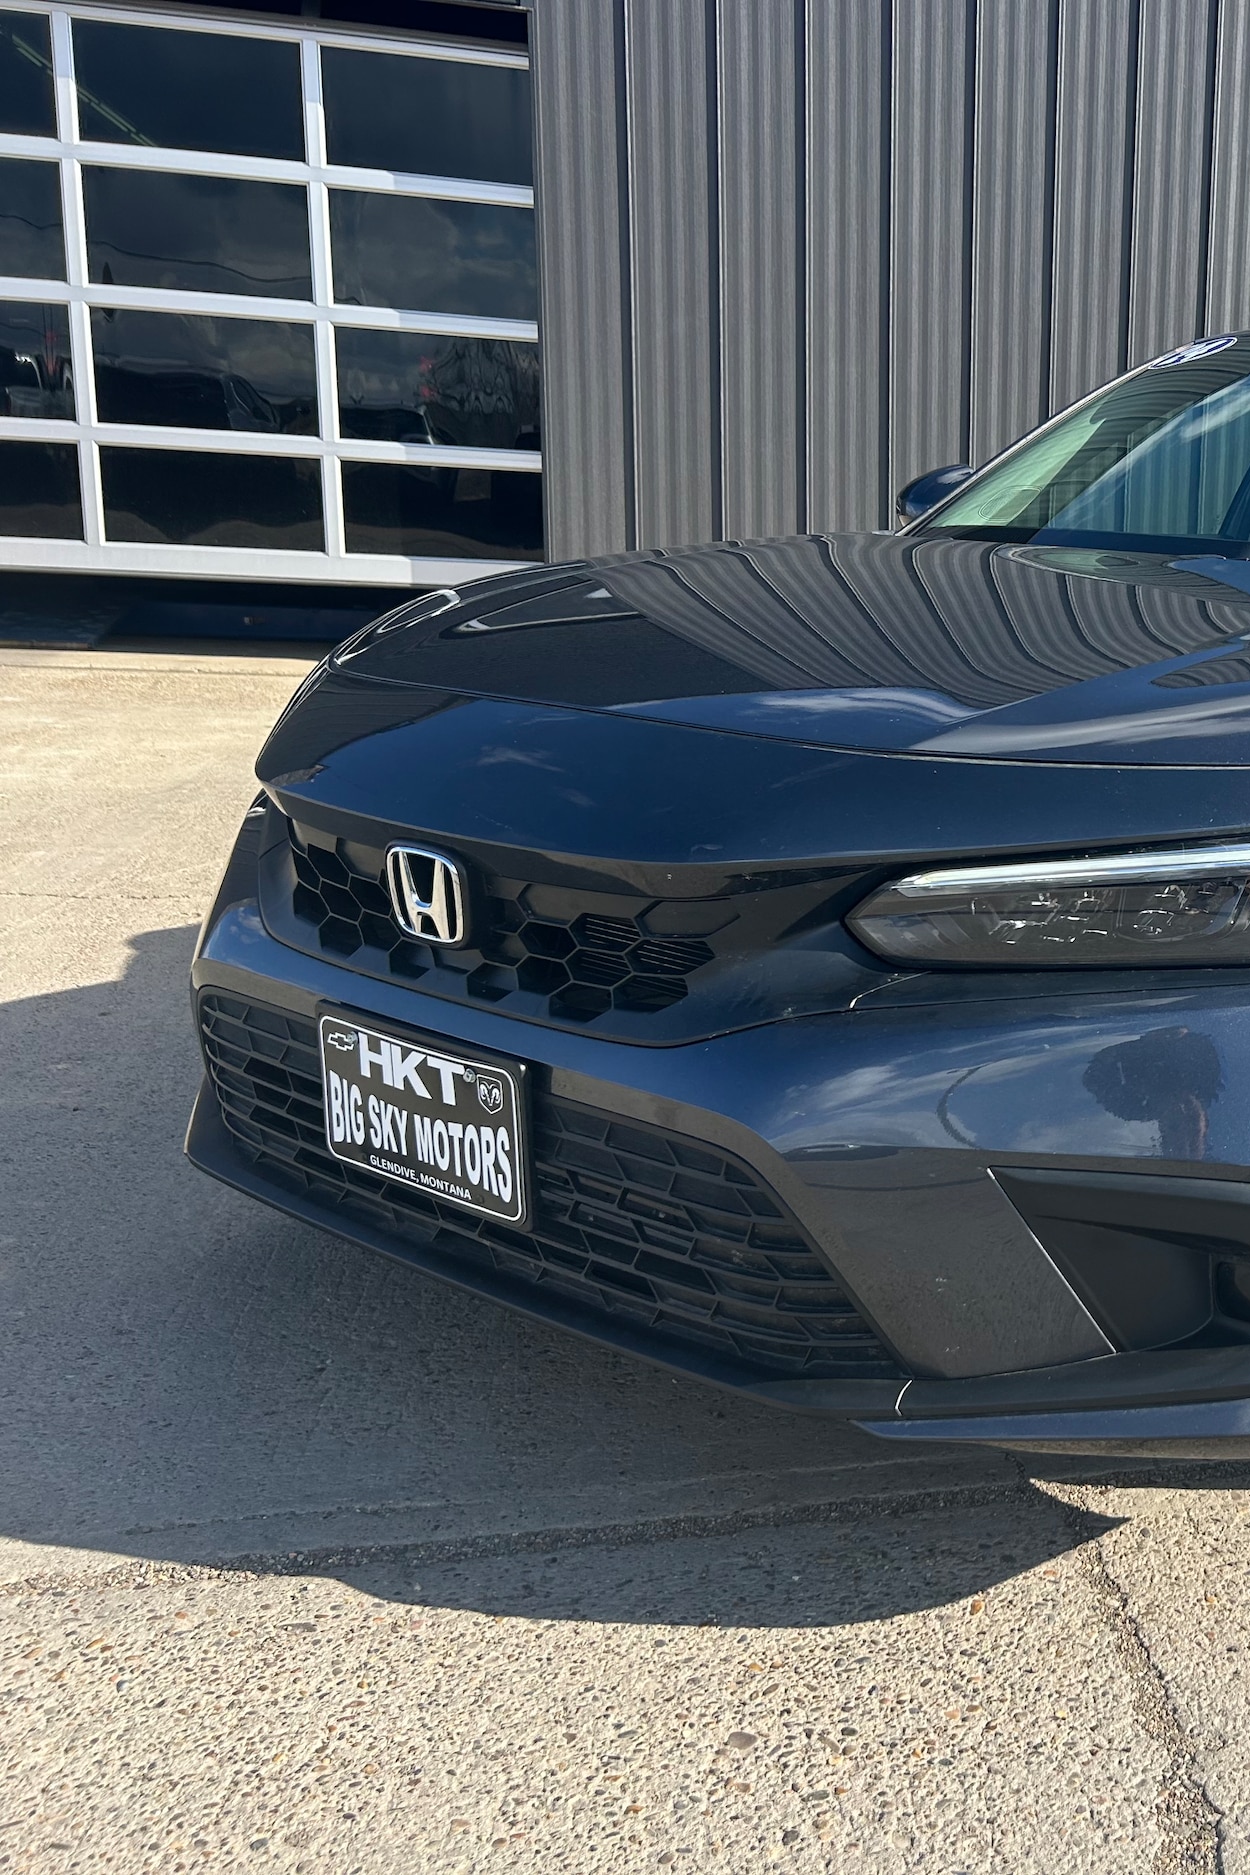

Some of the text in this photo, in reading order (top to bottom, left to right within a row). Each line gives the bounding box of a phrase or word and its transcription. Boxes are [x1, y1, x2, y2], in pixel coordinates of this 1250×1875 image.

[358, 1031, 466, 1107] HKT
[329, 1069, 513, 1204] BIG SKY MOTORS
[370, 1154, 472, 1201] GLENDIVE, MONTANA
